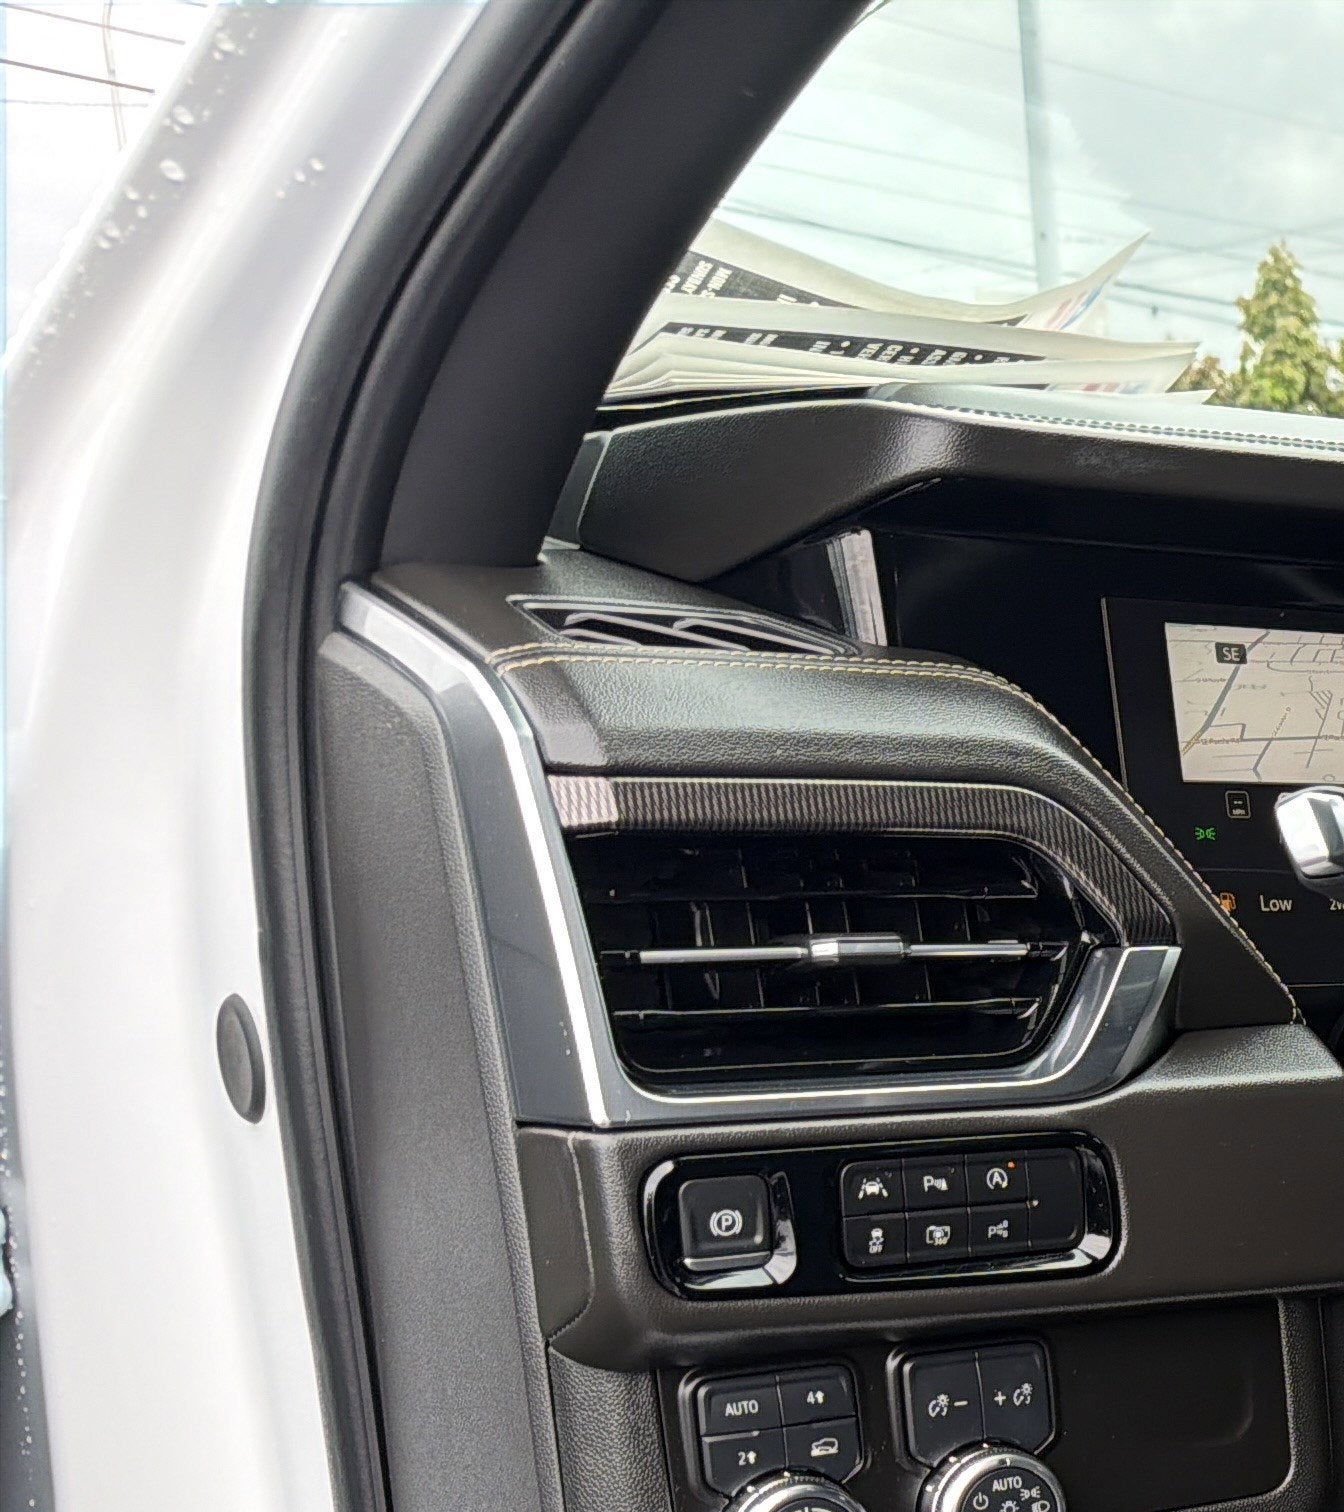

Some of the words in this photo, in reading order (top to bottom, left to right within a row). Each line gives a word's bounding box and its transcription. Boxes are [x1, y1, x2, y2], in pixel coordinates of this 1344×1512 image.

[1222, 646, 1241, 662] SE
[1260, 894, 1293, 912] Low
[725, 1399, 759, 1417] AUTO
[992, 1475, 1023, 1493] AUTO
